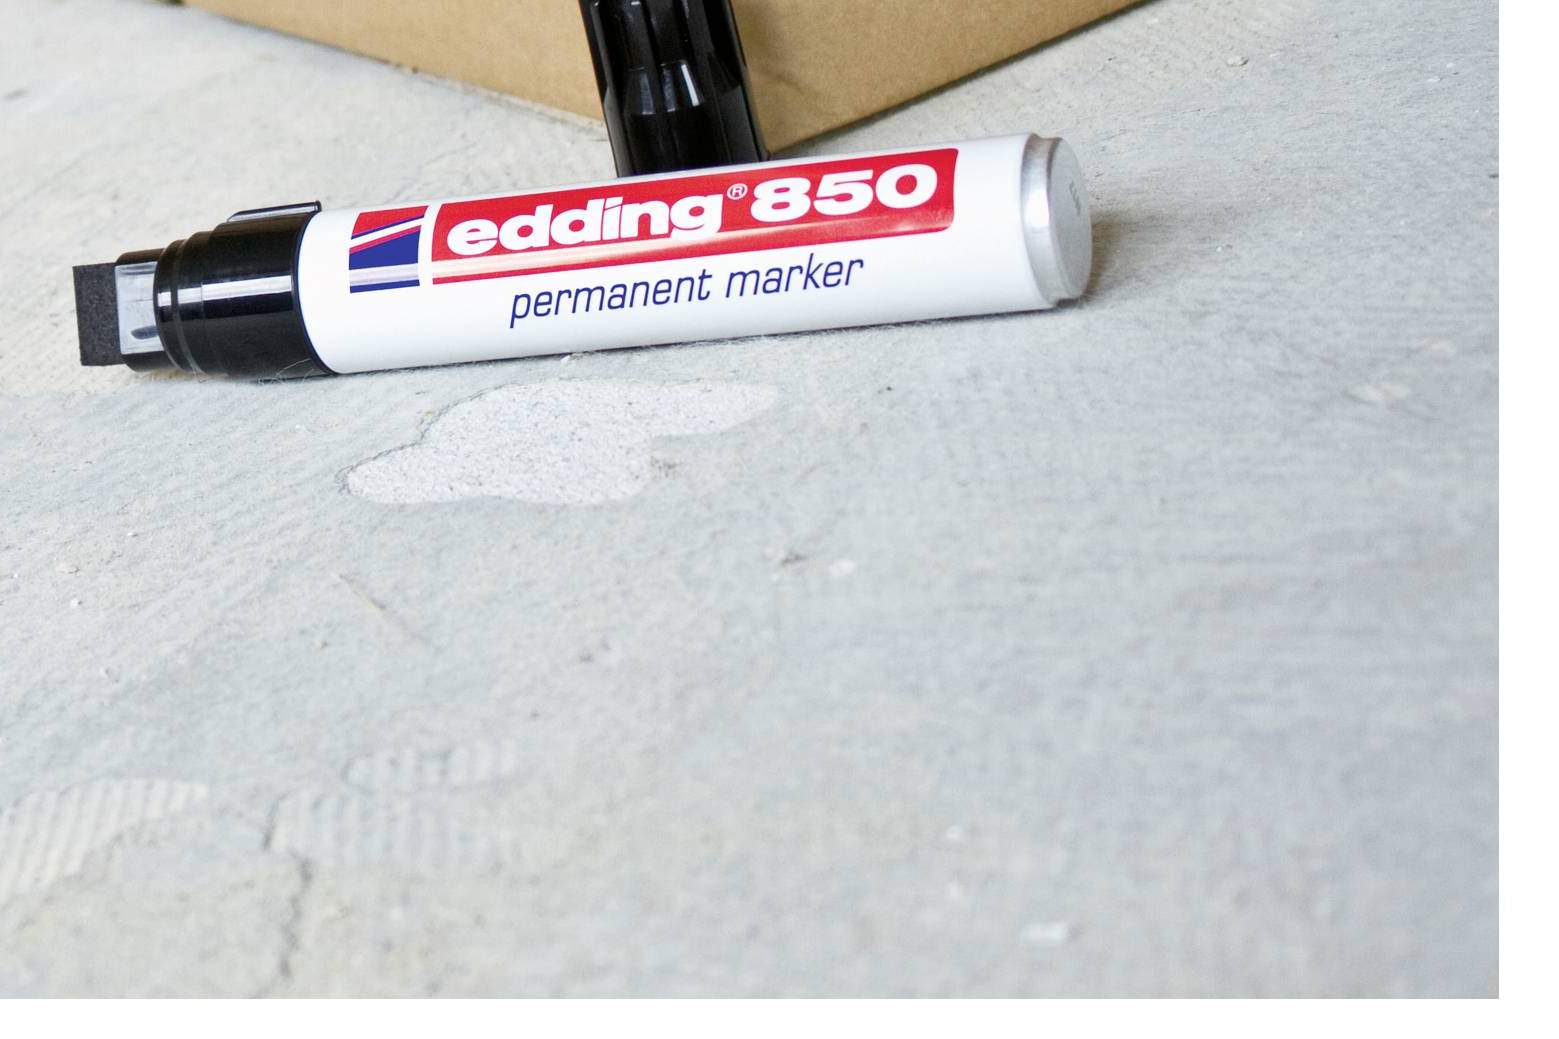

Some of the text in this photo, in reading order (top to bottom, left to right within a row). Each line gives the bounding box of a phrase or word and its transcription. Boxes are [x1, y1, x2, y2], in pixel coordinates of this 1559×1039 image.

[749, 163, 939, 224] 850
[509, 252, 865, 329] permanent marker
